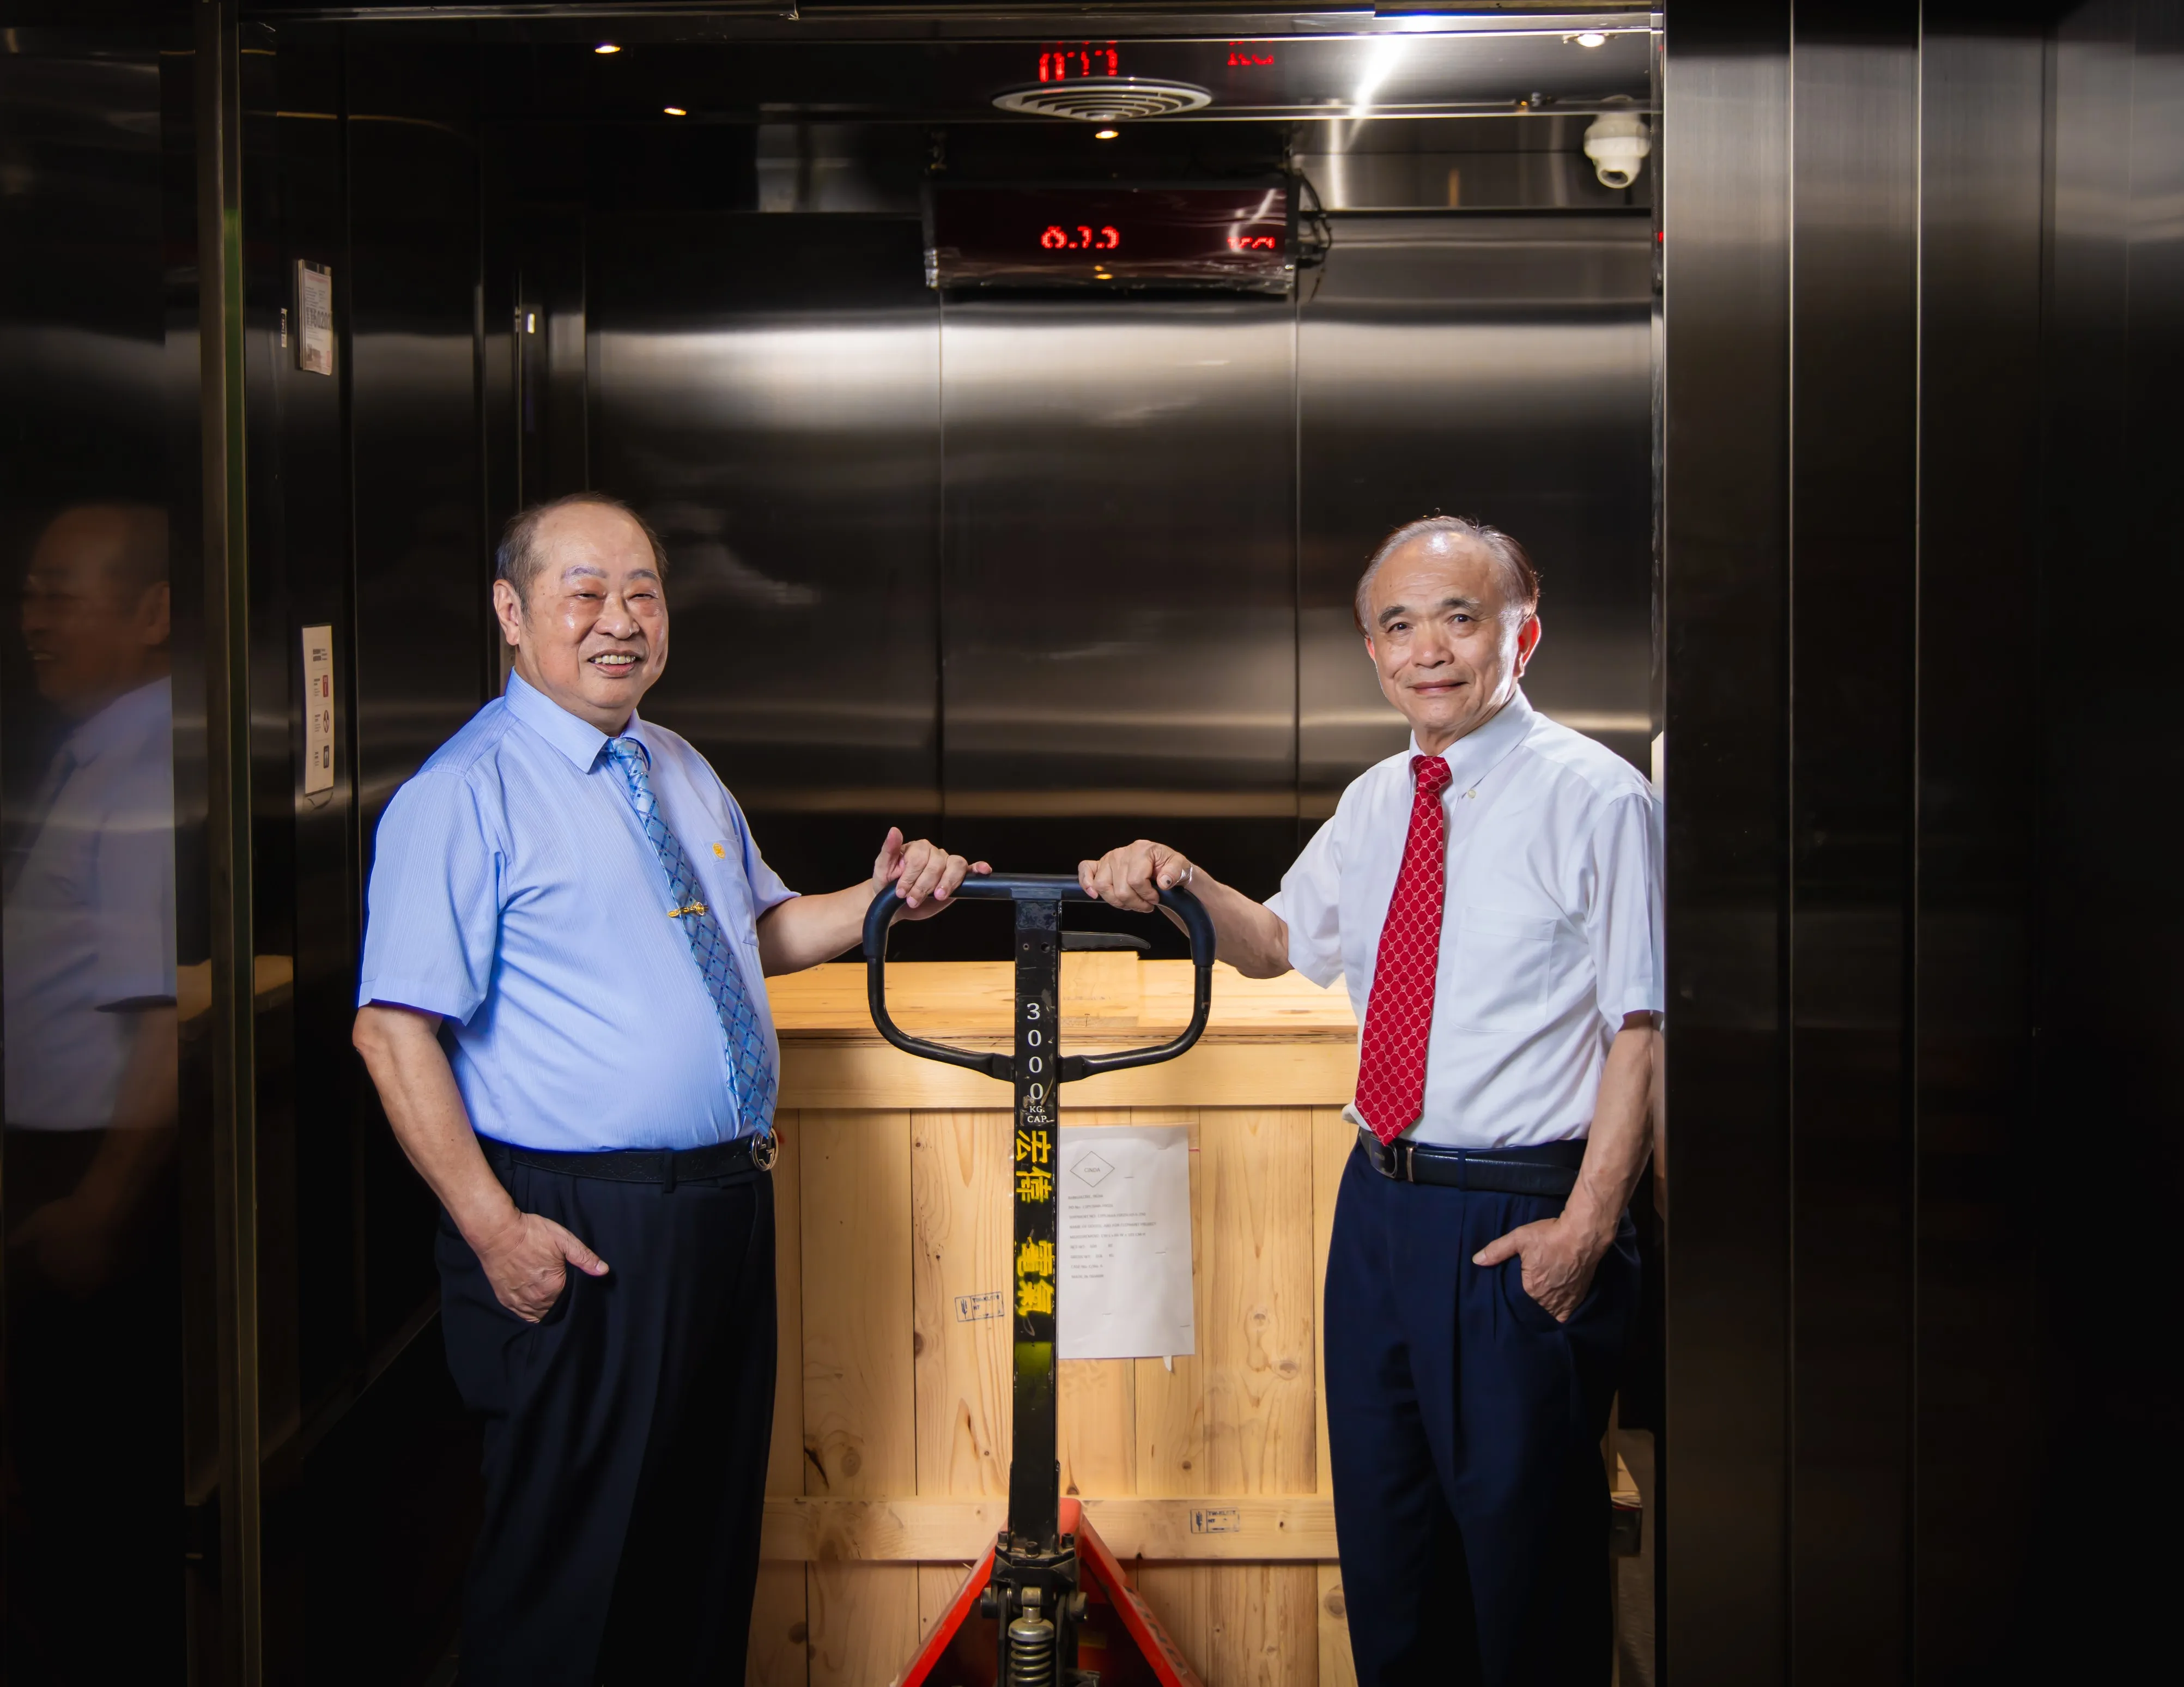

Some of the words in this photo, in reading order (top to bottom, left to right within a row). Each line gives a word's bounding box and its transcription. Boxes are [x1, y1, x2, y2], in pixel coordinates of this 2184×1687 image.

[1027, 1003, 1044, 1100] 3000
[1016, 1130, 1052, 1203] 宏偉
[1017, 1237, 1055, 1316] 電氣
